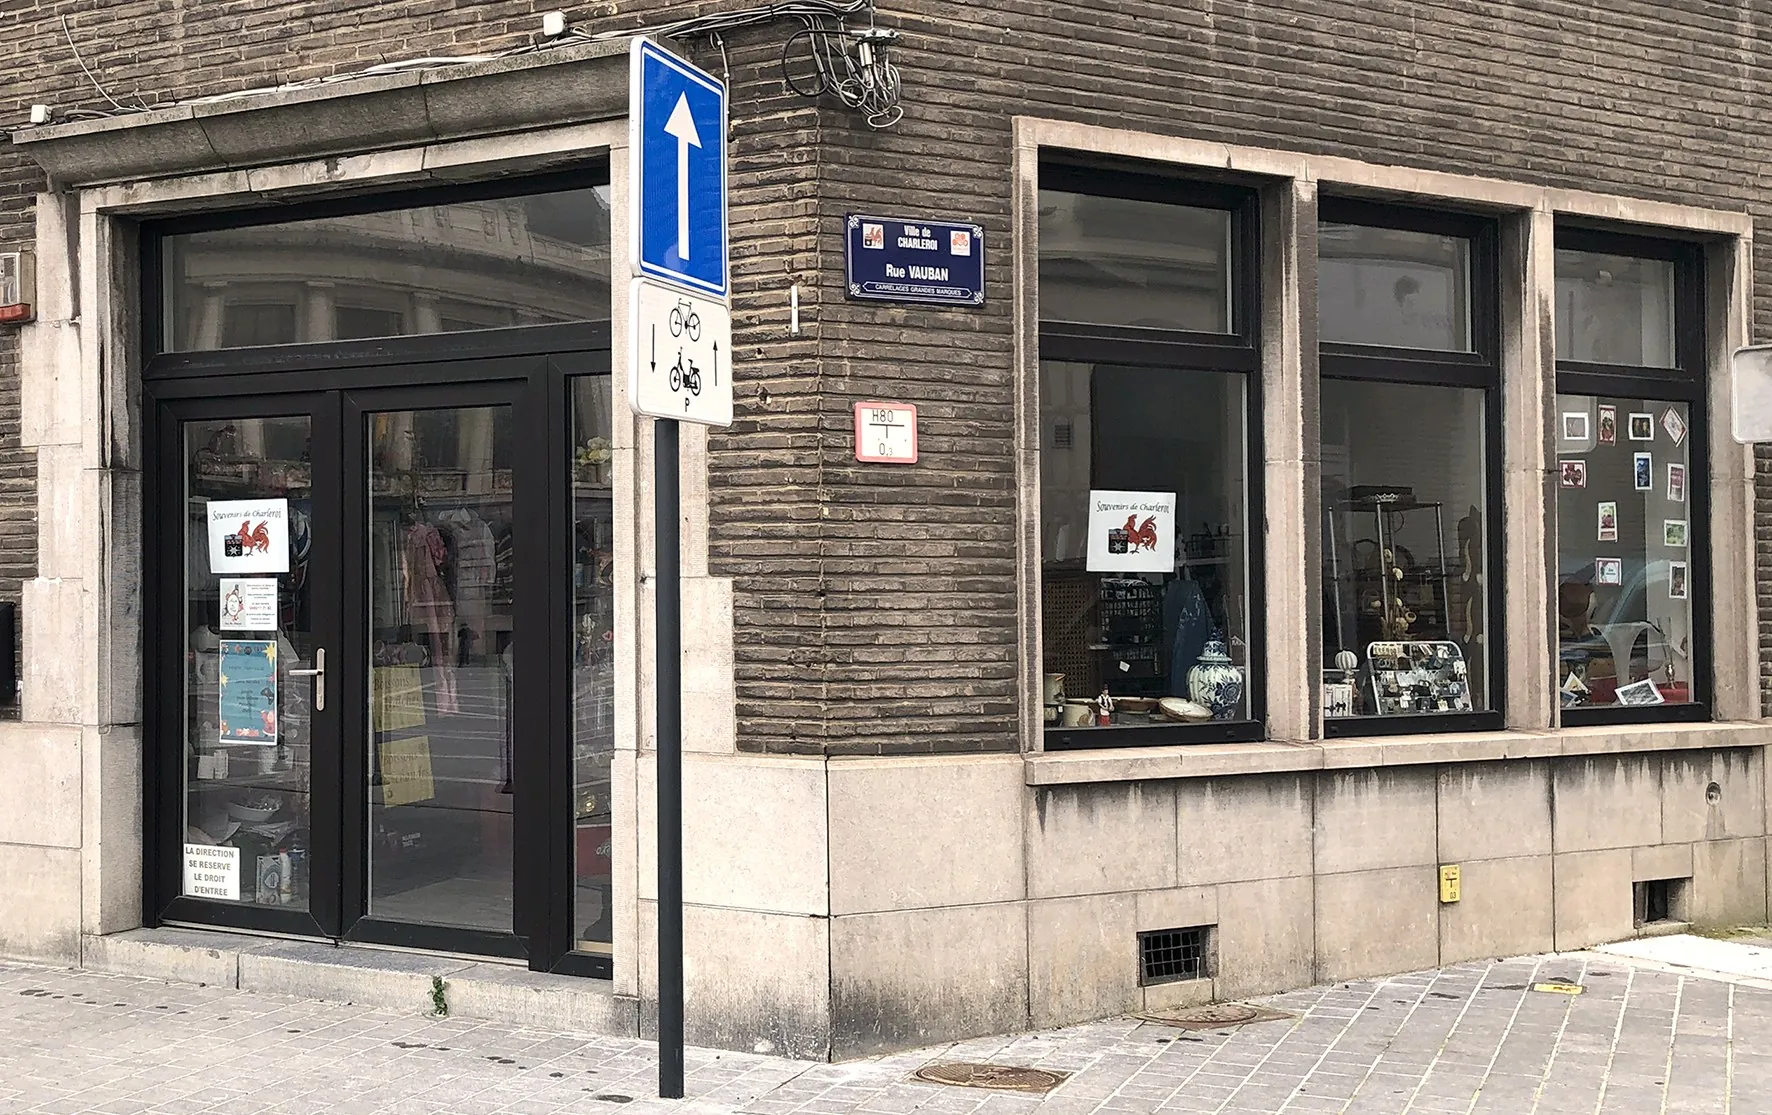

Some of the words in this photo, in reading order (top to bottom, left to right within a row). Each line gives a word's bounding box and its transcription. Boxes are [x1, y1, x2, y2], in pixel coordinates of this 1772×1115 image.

[904, 225, 920, 237] Ville
[921, 227, 931, 237] de
[897, 237, 938, 251] CHARLEROI
[885, 263, 906, 278] Rue
[908, 265, 949, 281] VAUBAN
[875, 284, 910, 293] CARRELAGES
[910, 286, 936, 294] GRANDES
[936, 288, 962, 296] MARQUES
[684, 397, 690, 413] P
[1096, 500, 1129, 513] Souvenirs
[1130, 502, 1138, 511] de
[1139, 501, 1170, 514] Charleroi
[212, 509, 242, 521] Souvenirs
[243, 510, 251, 518] de
[251, 508, 282, 519] Charleroi
[185, 846, 194, 855] LA
[195, 848, 235, 858] DIRECTION
[188, 859, 197, 868] SE
[194, 873, 202, 881] LE
[204, 873, 226, 883] DROIT
